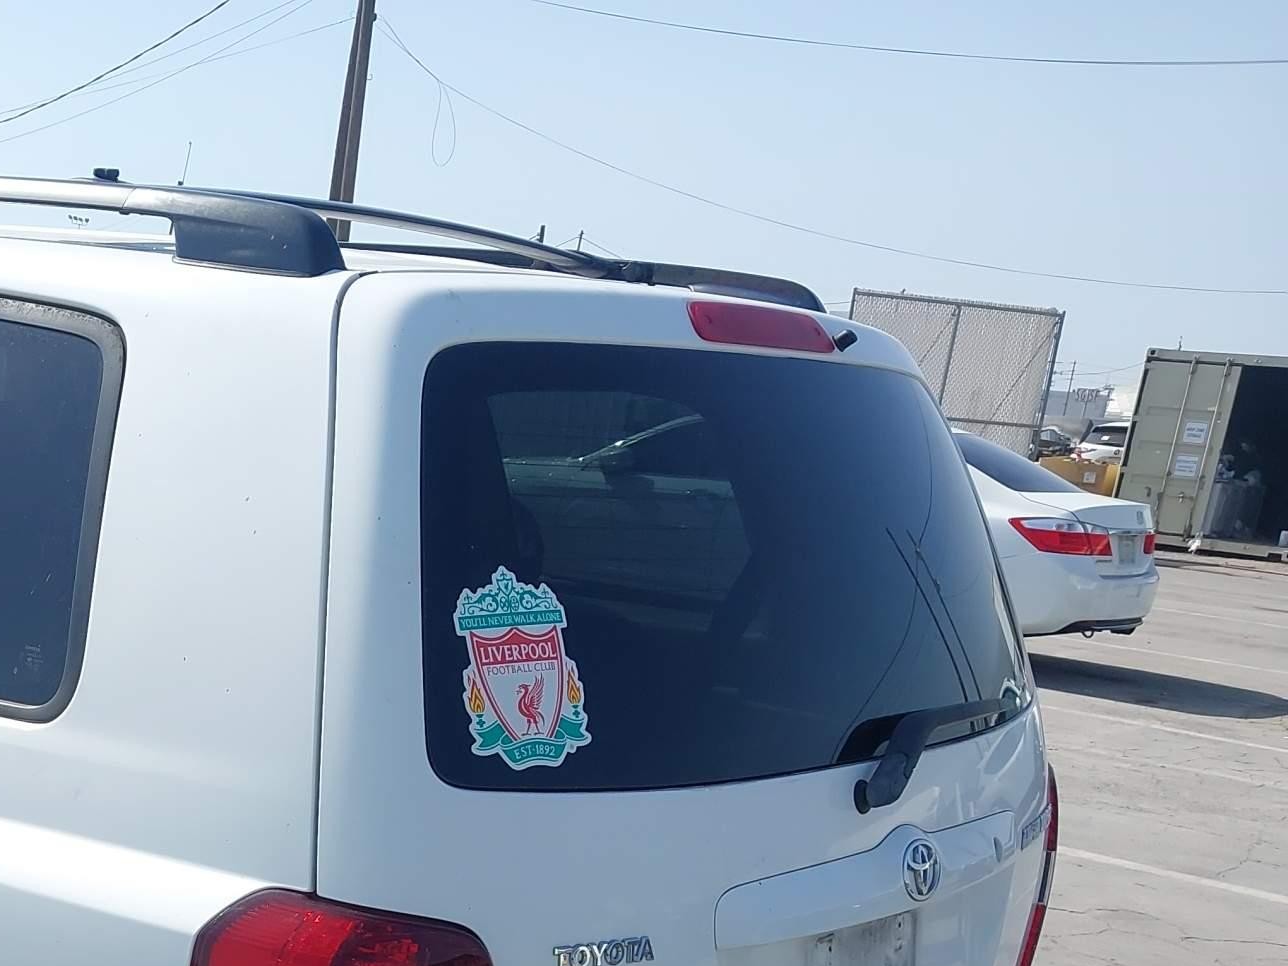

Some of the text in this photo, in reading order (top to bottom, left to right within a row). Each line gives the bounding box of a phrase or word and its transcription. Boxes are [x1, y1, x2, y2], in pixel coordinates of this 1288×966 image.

[460, 611, 562, 628] YOU'LL NEVER WALK ALONE
[479, 641, 557, 663] LIVERPOOL
[486, 661, 556, 676] FOOTBALL CLUB
